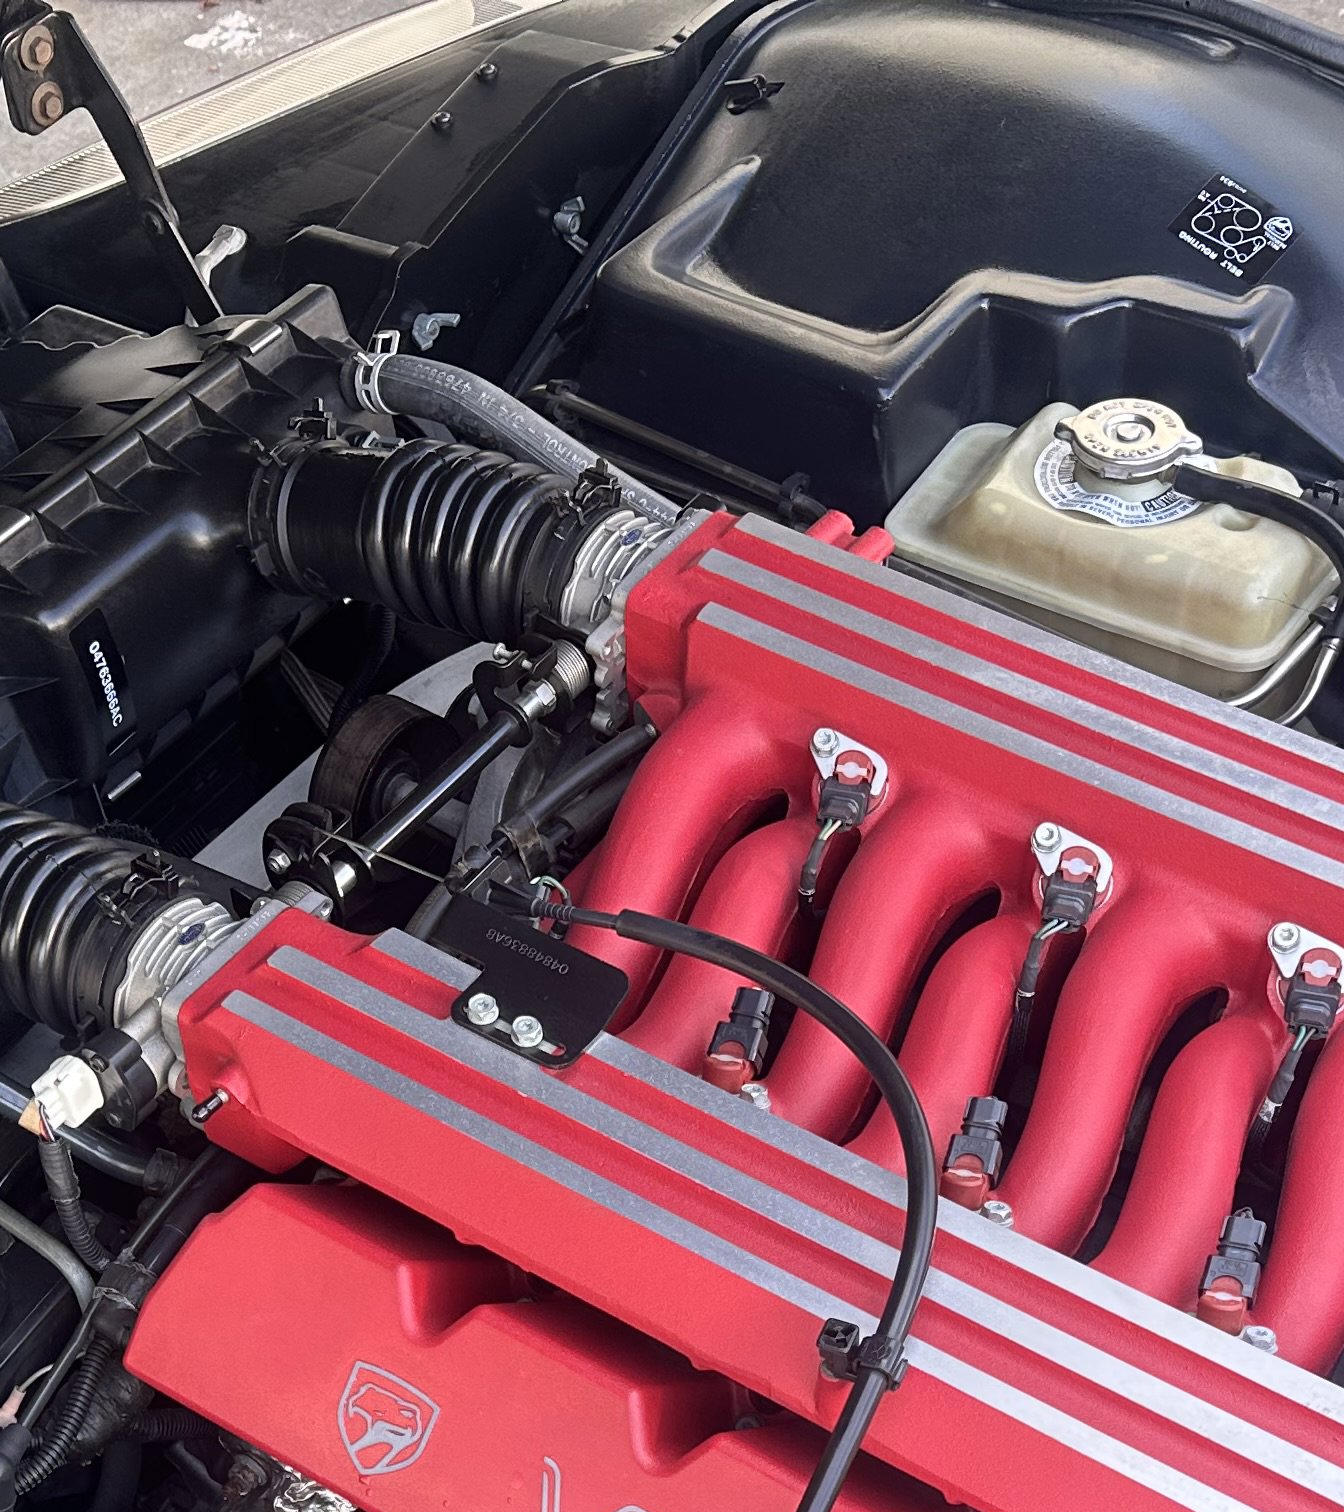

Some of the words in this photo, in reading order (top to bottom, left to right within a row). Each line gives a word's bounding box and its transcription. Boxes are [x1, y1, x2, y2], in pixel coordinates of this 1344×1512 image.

[1177, 230, 1218, 260] ROUTING
[1219, 258, 1243, 277] BELT
[87, 640, 124, 727] 04763666AC
